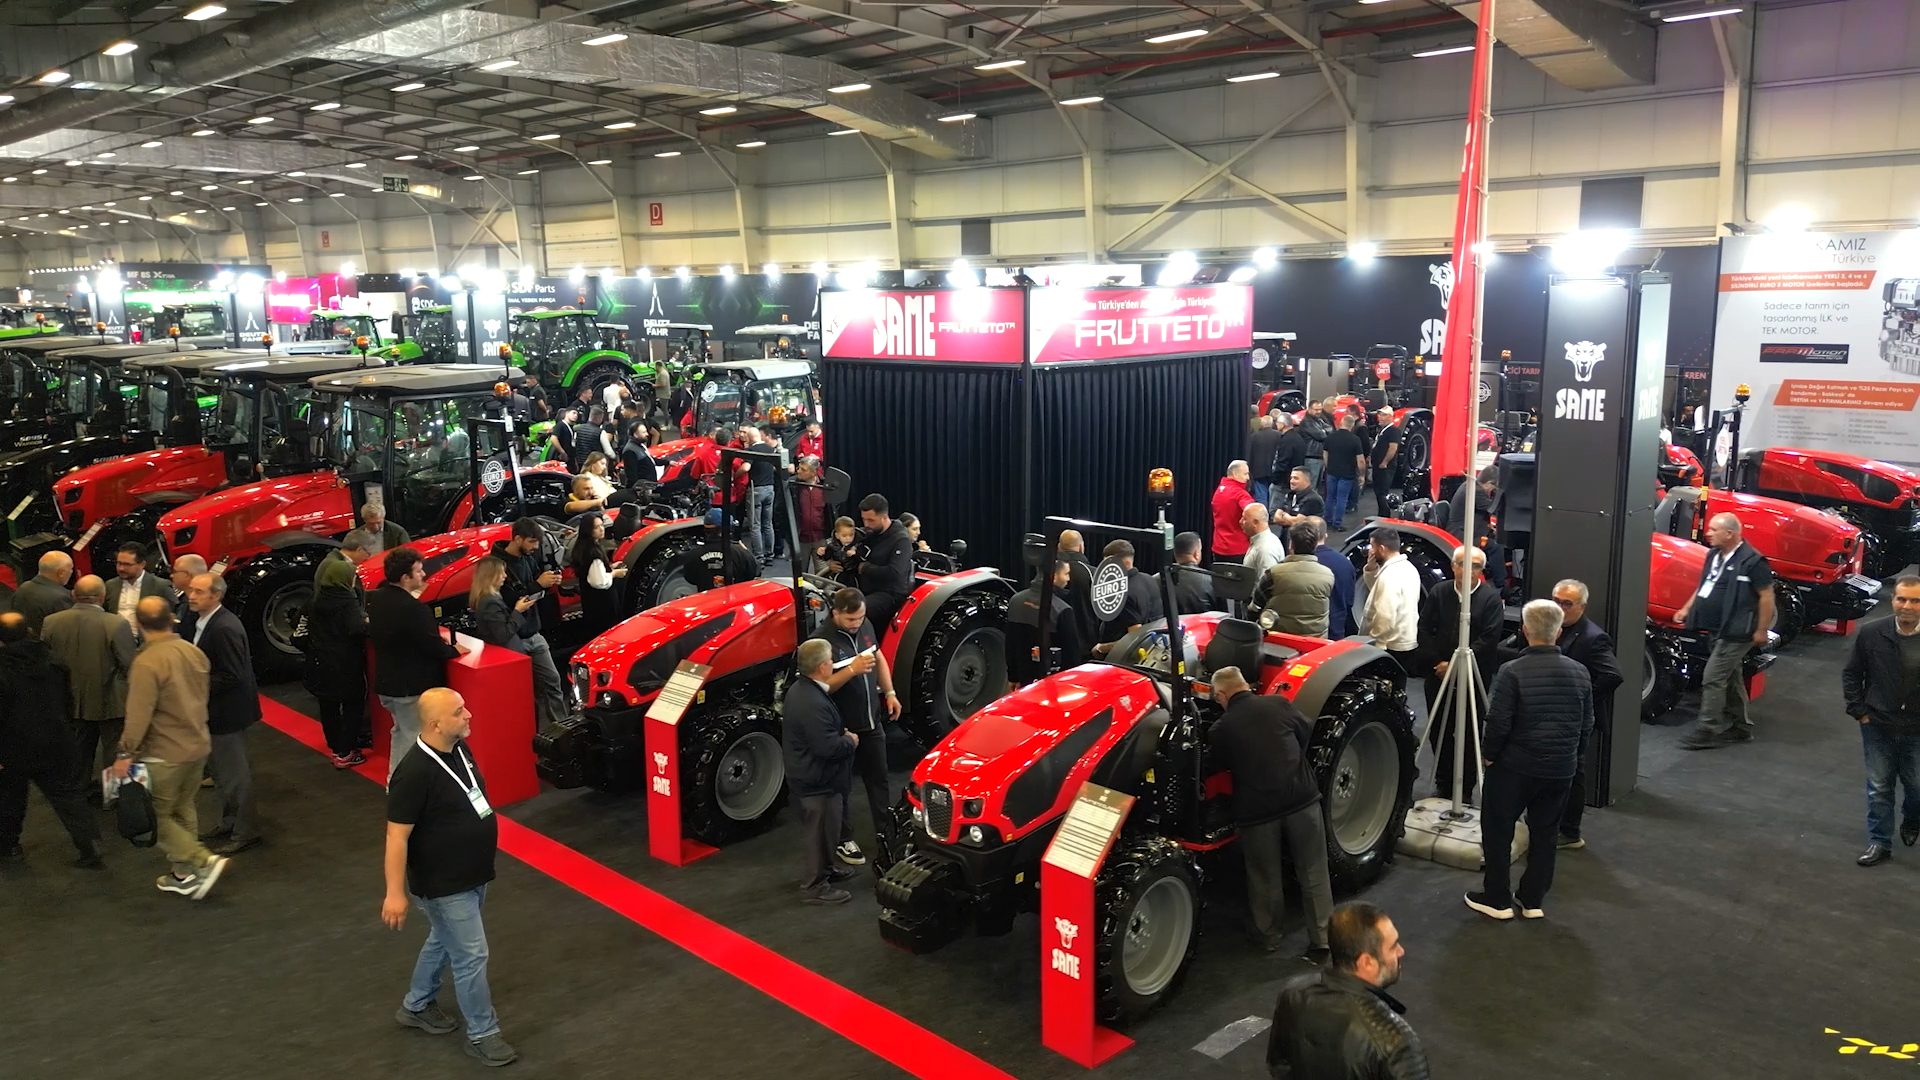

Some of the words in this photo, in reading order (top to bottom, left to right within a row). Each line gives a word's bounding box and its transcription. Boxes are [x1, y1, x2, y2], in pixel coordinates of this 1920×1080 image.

[652, 204, 660, 220] D
[1832, 253, 1876, 265] Türkiye
[535, 284, 556, 294] Parts
[1833, 303, 1849, 311] için
[873, 295, 936, 357] SAME
[1763, 315, 1817, 323] tasarlanmış
[646, 328, 668, 336] FAHR
[1420, 319, 1447, 355] SA
[1762, 327, 1777, 335] TEK
[1555, 388, 1606, 421] SAME
[1095, 581, 1119, 598] EURO
[1120, 579, 1126, 591] 5
[653, 775, 671, 797] SAME
[1051, 948, 1081, 980] SAME
